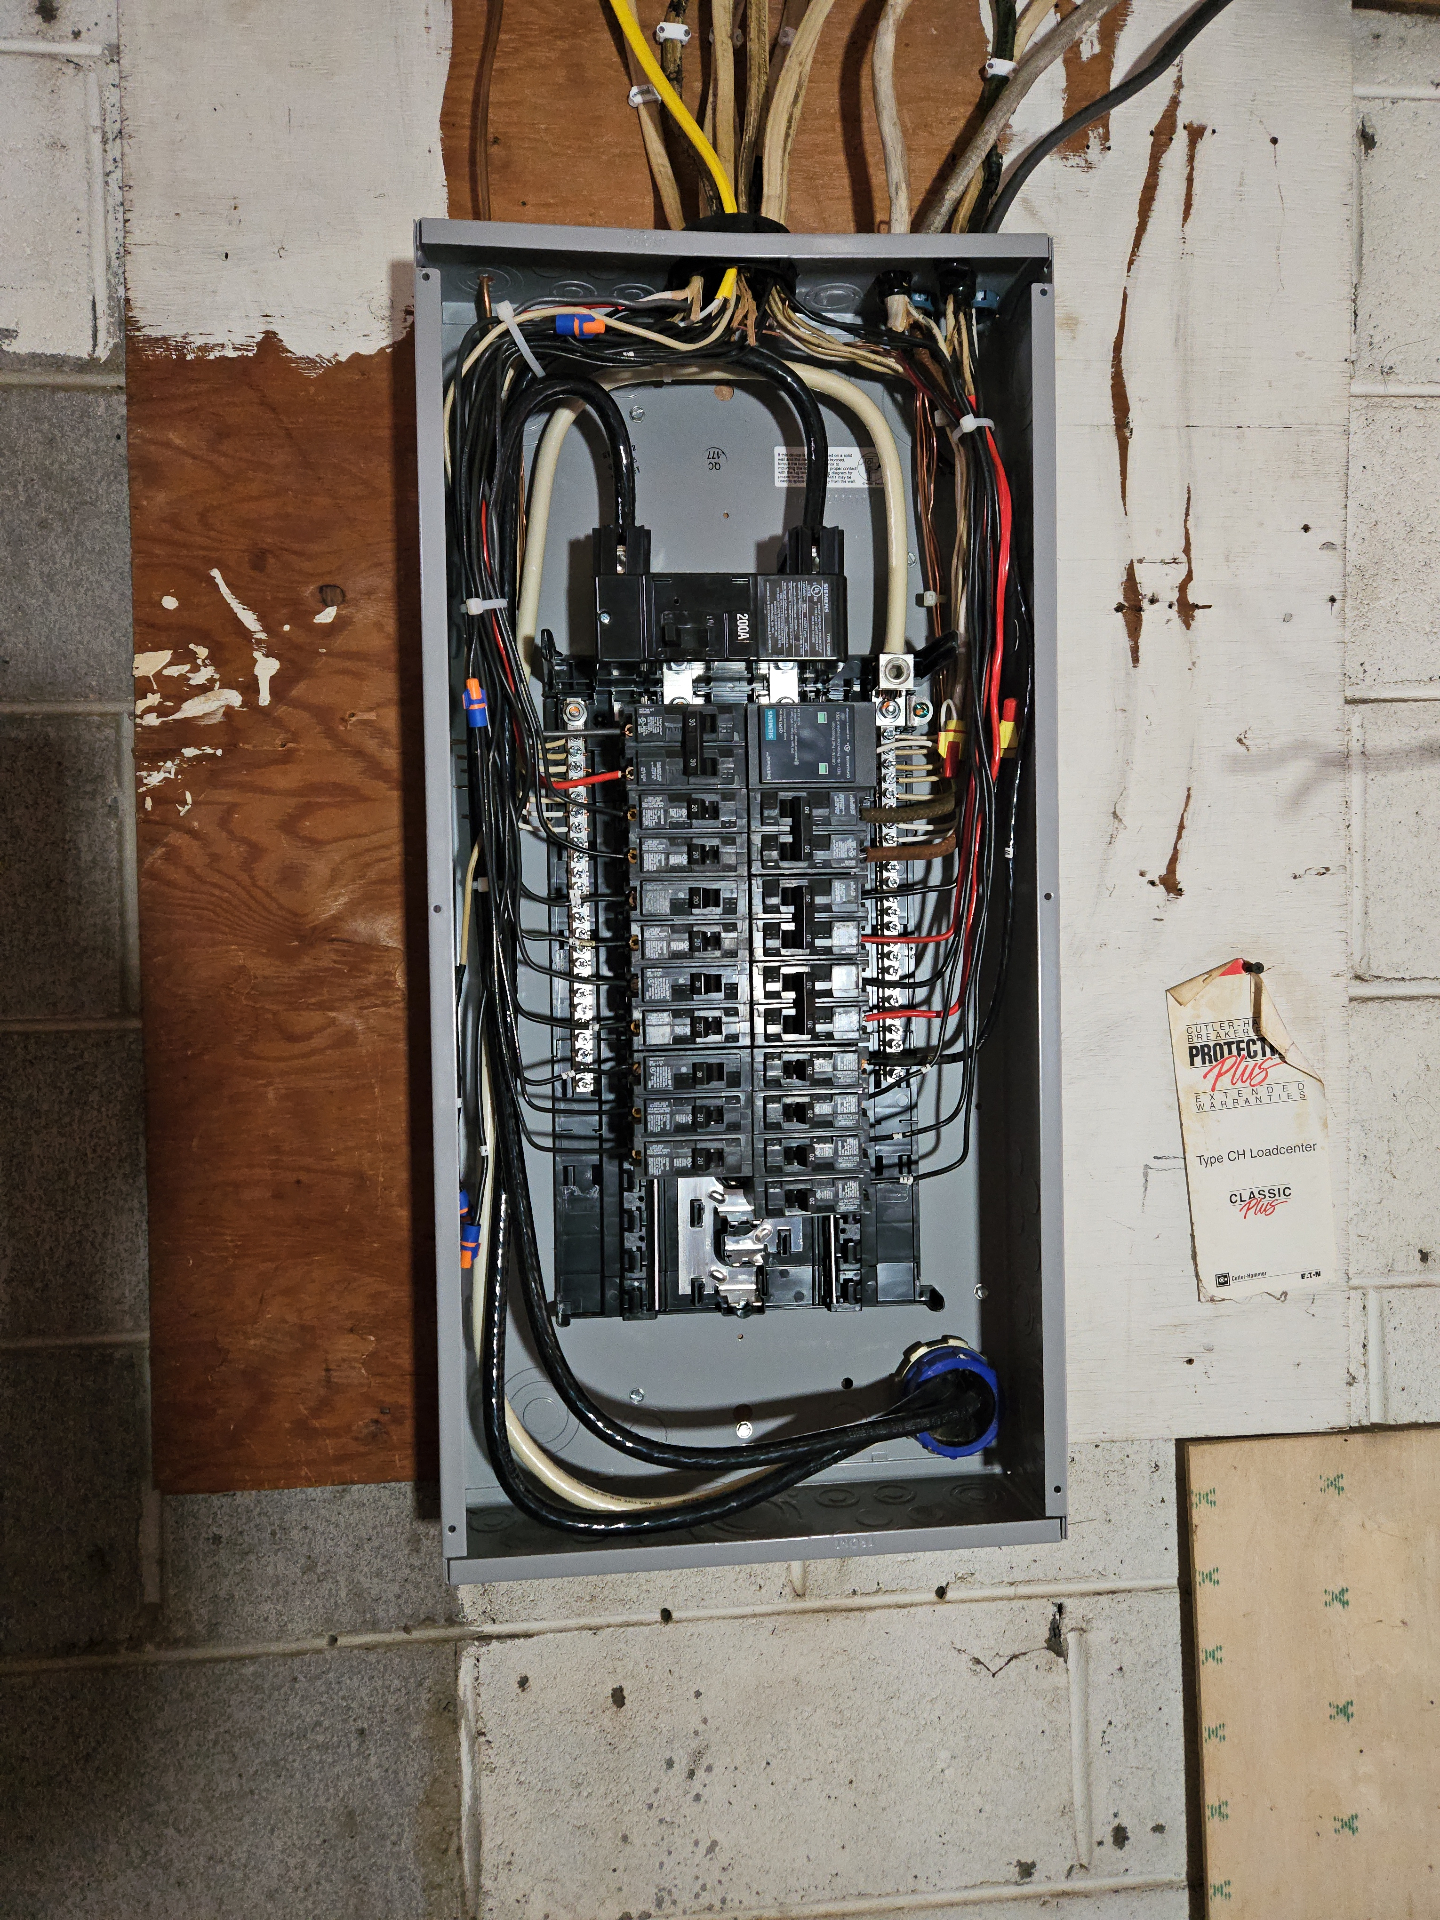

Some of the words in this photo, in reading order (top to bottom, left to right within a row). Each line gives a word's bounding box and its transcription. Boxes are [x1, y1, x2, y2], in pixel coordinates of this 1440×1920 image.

[708, 462, 720, 470] QC
[736, 613, 749, 640] 200A
[694, 896, 699, 904] 20
[1188, 1029, 1249, 1042] BREAKER
[1203, 1054, 1286, 1092] Plus
[1196, 1083, 1305, 1102] EXTENDED
[1196, 1091, 1306, 1111] WARRANTIES
[1196, 1154, 1224, 1168] Type
[1227, 1149, 1246, 1161] CH
[1250, 1143, 1317, 1158] Loadcenter
[1229, 1187, 1292, 1204] CLASSIC
[1239, 1198, 1288, 1219] Plus
